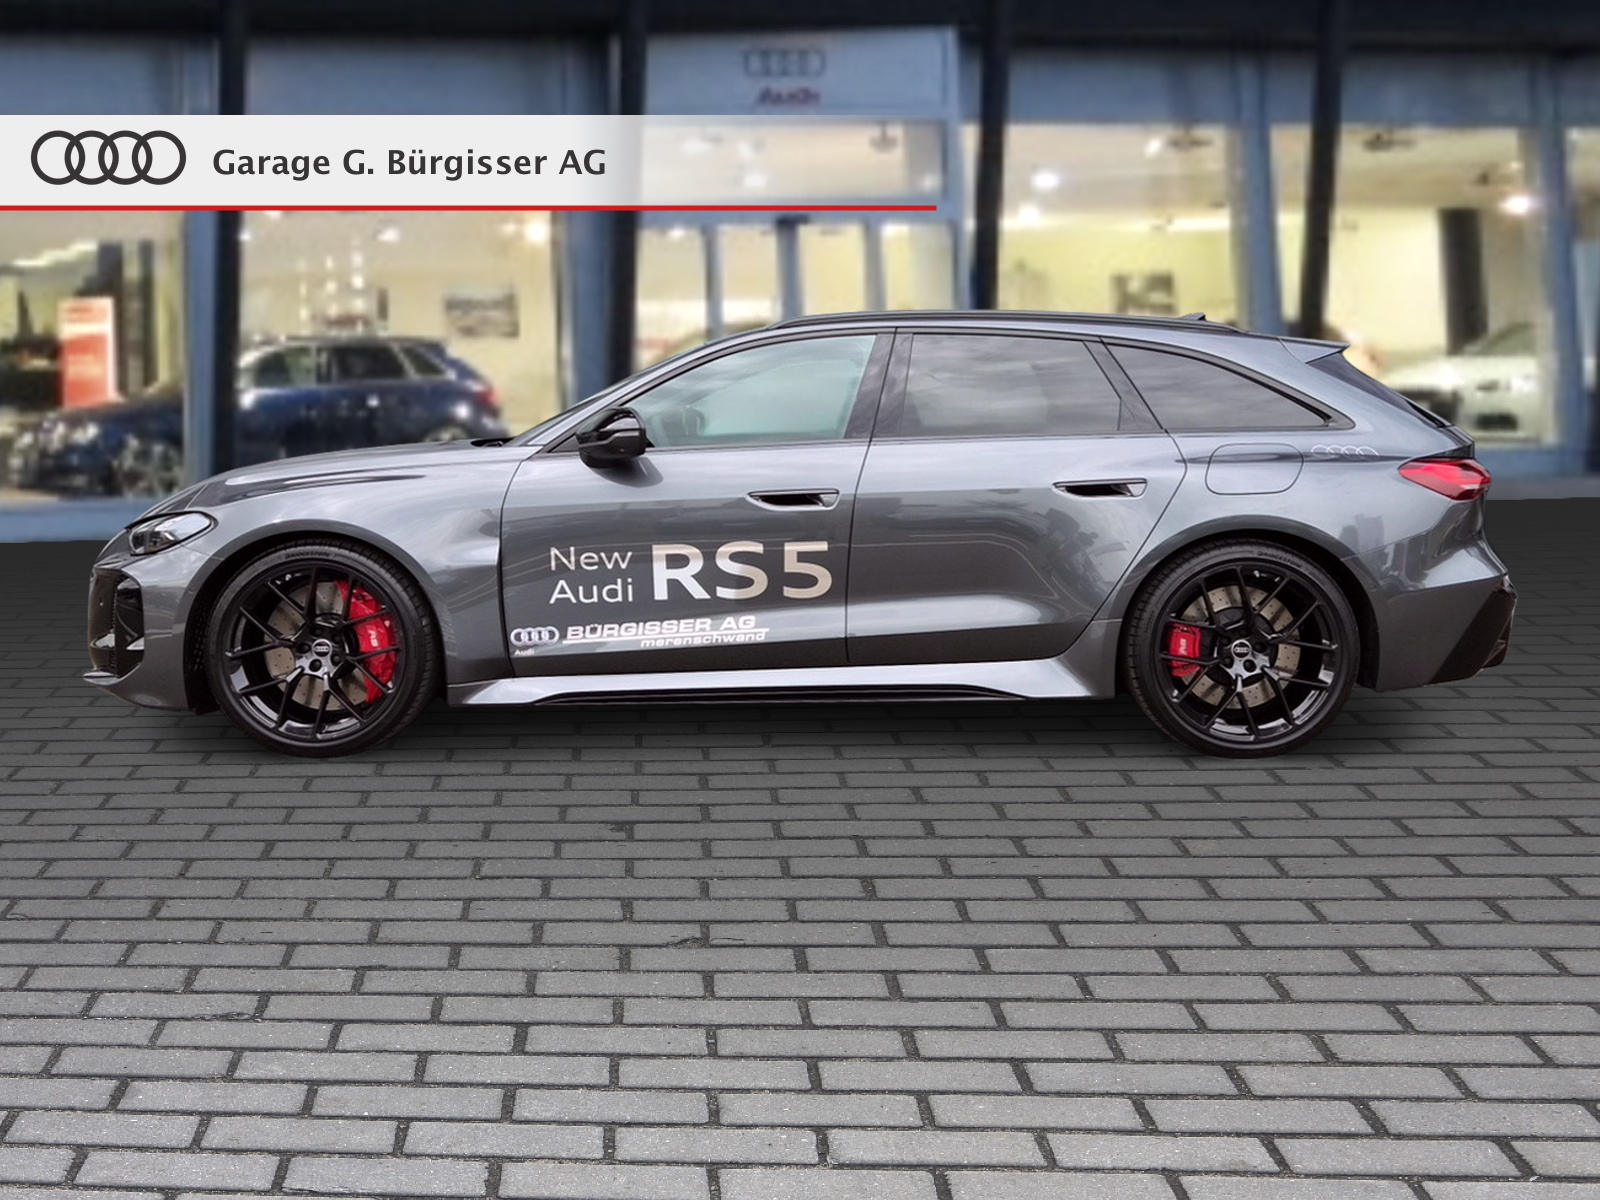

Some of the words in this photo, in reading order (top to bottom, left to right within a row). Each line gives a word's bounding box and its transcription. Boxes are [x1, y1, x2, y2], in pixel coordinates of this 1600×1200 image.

[550, 546, 633, 571] New
[549, 577, 633, 604] Audi
[566, 617, 712, 641] BÜRGISSER
[719, 615, 757, 631] AG
